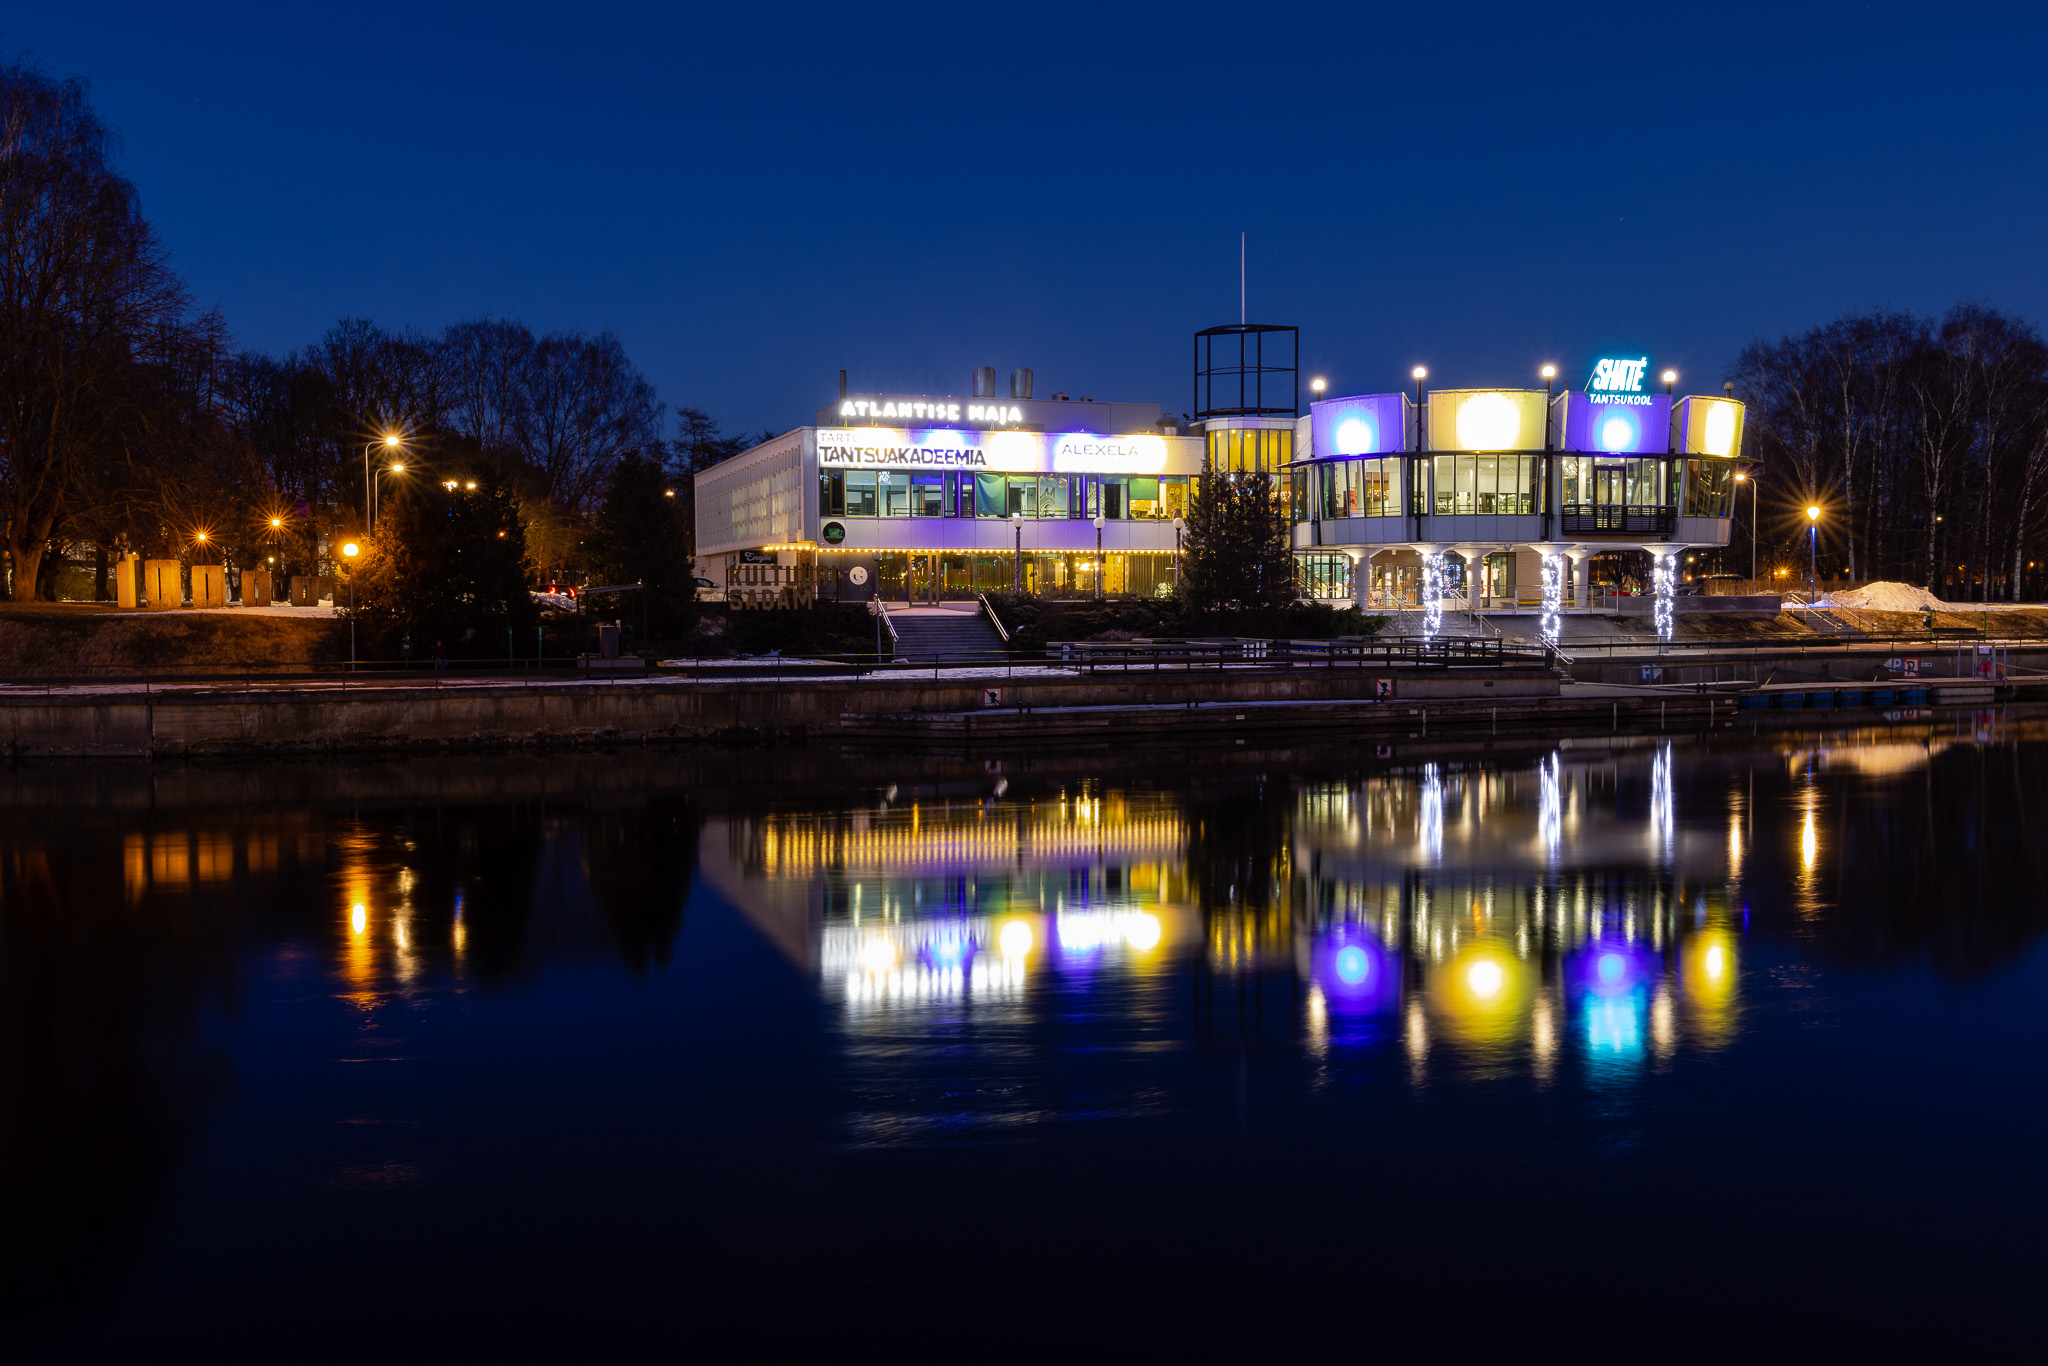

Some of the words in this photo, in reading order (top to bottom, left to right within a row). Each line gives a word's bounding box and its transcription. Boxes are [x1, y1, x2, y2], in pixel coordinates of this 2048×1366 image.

[1590, 394, 1652, 405] TANTSUKOOL
[840, 401, 960, 420] ATLANTISE
[968, 404, 1023, 425] MAJA
[819, 446, 987, 466] TANTSUAKADEEMIA
[1062, 444, 1139, 456] ALEXELA
[729, 565, 837, 587] KULTUURI
[729, 589, 813, 611] SADAM
